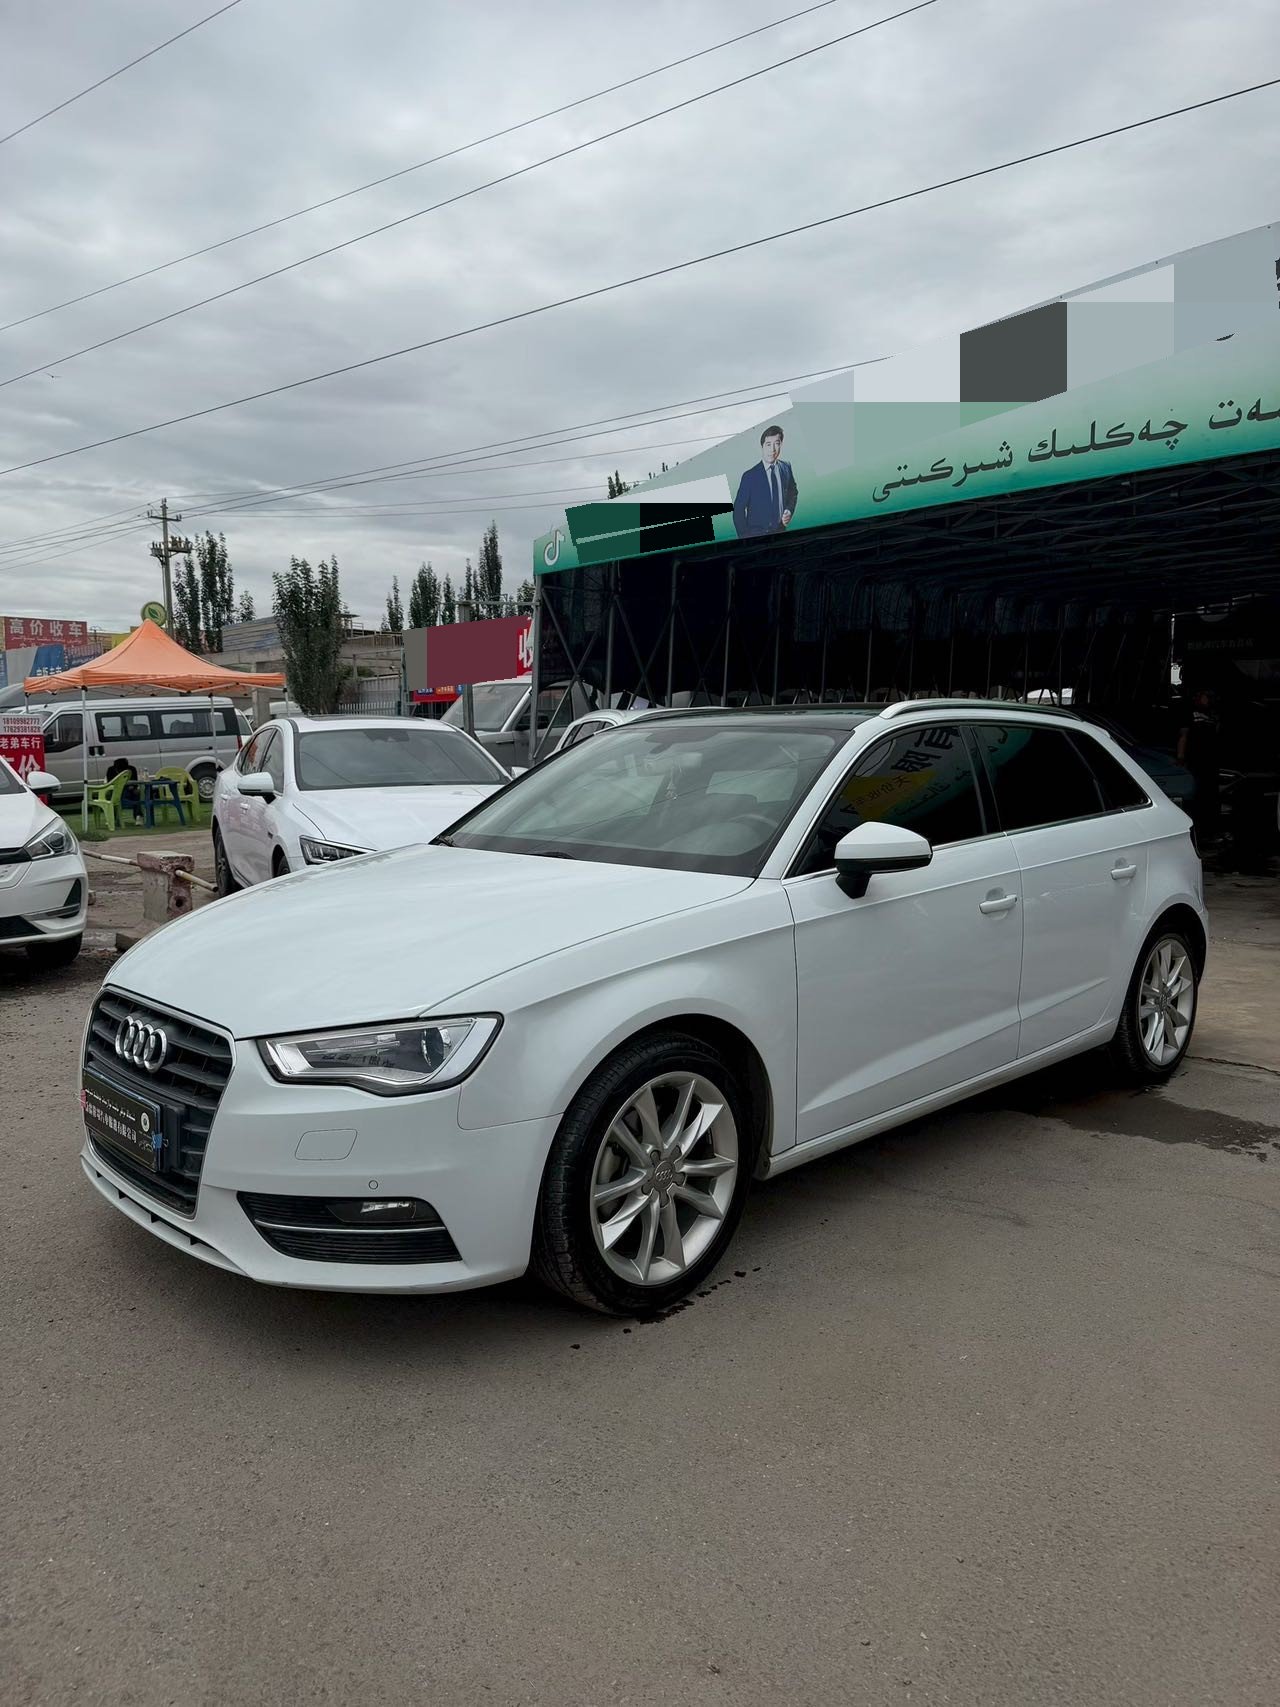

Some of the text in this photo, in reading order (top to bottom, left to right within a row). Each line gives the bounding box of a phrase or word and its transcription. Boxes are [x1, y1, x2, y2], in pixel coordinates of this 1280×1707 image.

[9, 618, 83, 638] 高价收车
[0, 736, 41, 749] 老弟车行
